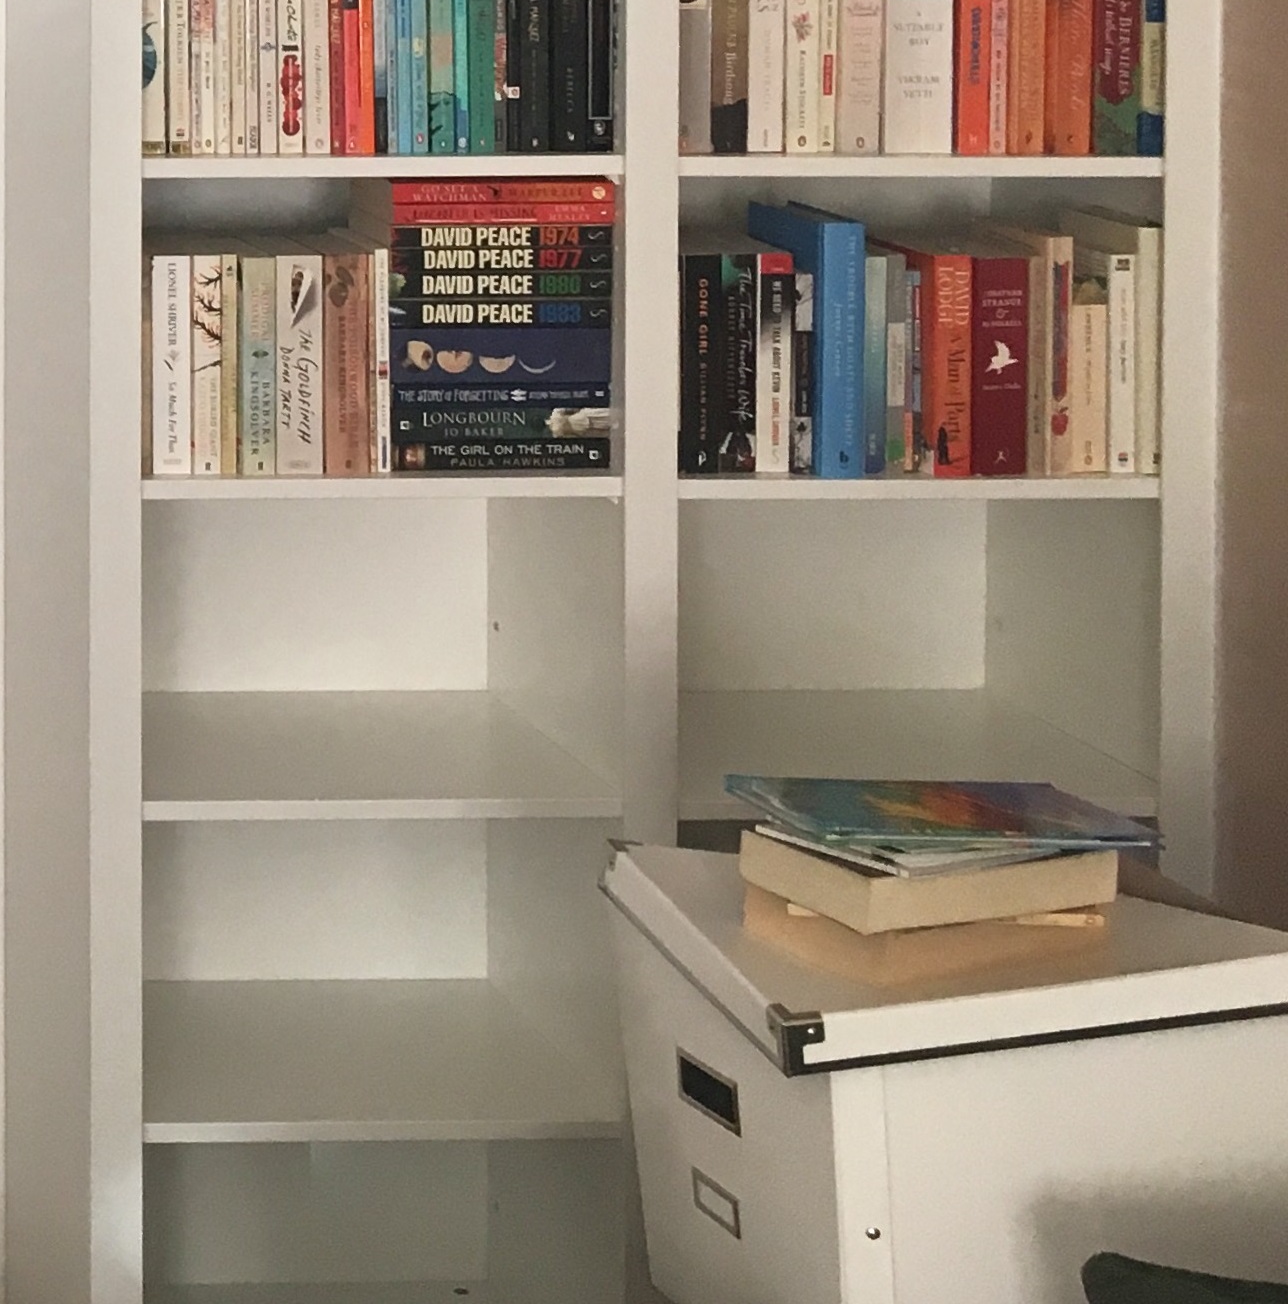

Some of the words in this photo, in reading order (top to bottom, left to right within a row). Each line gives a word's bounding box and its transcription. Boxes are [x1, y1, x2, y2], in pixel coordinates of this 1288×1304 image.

[1118, 17, 1133, 96] BERNIERES
[724, 52, 736, 106] Birdsong
[412, 193, 488, 203] WATCHMAN
[421, 227, 474, 247] DAVID
[476, 227, 531, 246] PEACE
[538, 227, 580, 246] 1974
[424, 250, 475, 269] DAVID
[479, 249, 534, 269] PEACE
[538, 249, 582, 268] 1977
[167, 262, 177, 299] LIONEL
[422, 275, 474, 294] DAVID
[477, 275, 533, 294] PEACE
[539, 275, 581, 294] 1980
[698, 278, 708, 318] GONE
[938, 266, 953, 329] LODGE
[954, 270, 970, 325] DAVID
[167, 303, 177, 346] SHRIVER
[422, 304, 474, 324] DAVID
[477, 304, 533, 323] PEACE
[299, 329, 311, 351] The
[698, 324, 709, 355] GIRL
[278, 346, 295, 384] DONNA
[169, 381, 177, 392] So
[169, 394, 177, 417] Much
[280, 389, 292, 430] TARTT
[293, 357, 319, 445] GOLDFINCH
[250, 371, 259, 456] KINGSOLVER
[262, 382, 271, 445] BARBARA
[423, 411, 526, 427] LONGBOURN
[169, 419, 177, 433] For
[444, 427, 460, 436] JO
[464, 427, 504, 436] BAKER
[169, 434, 177, 453] That
[431, 445, 456, 455] THE
[461, 445, 490, 455] GIRL
[495, 445, 513, 454] ON
[517, 445, 542, 454] THE
[546, 444, 584, 454] TRAIN
[450, 458, 494, 467] PAULA
[503, 457, 565, 466] HAWKINS
